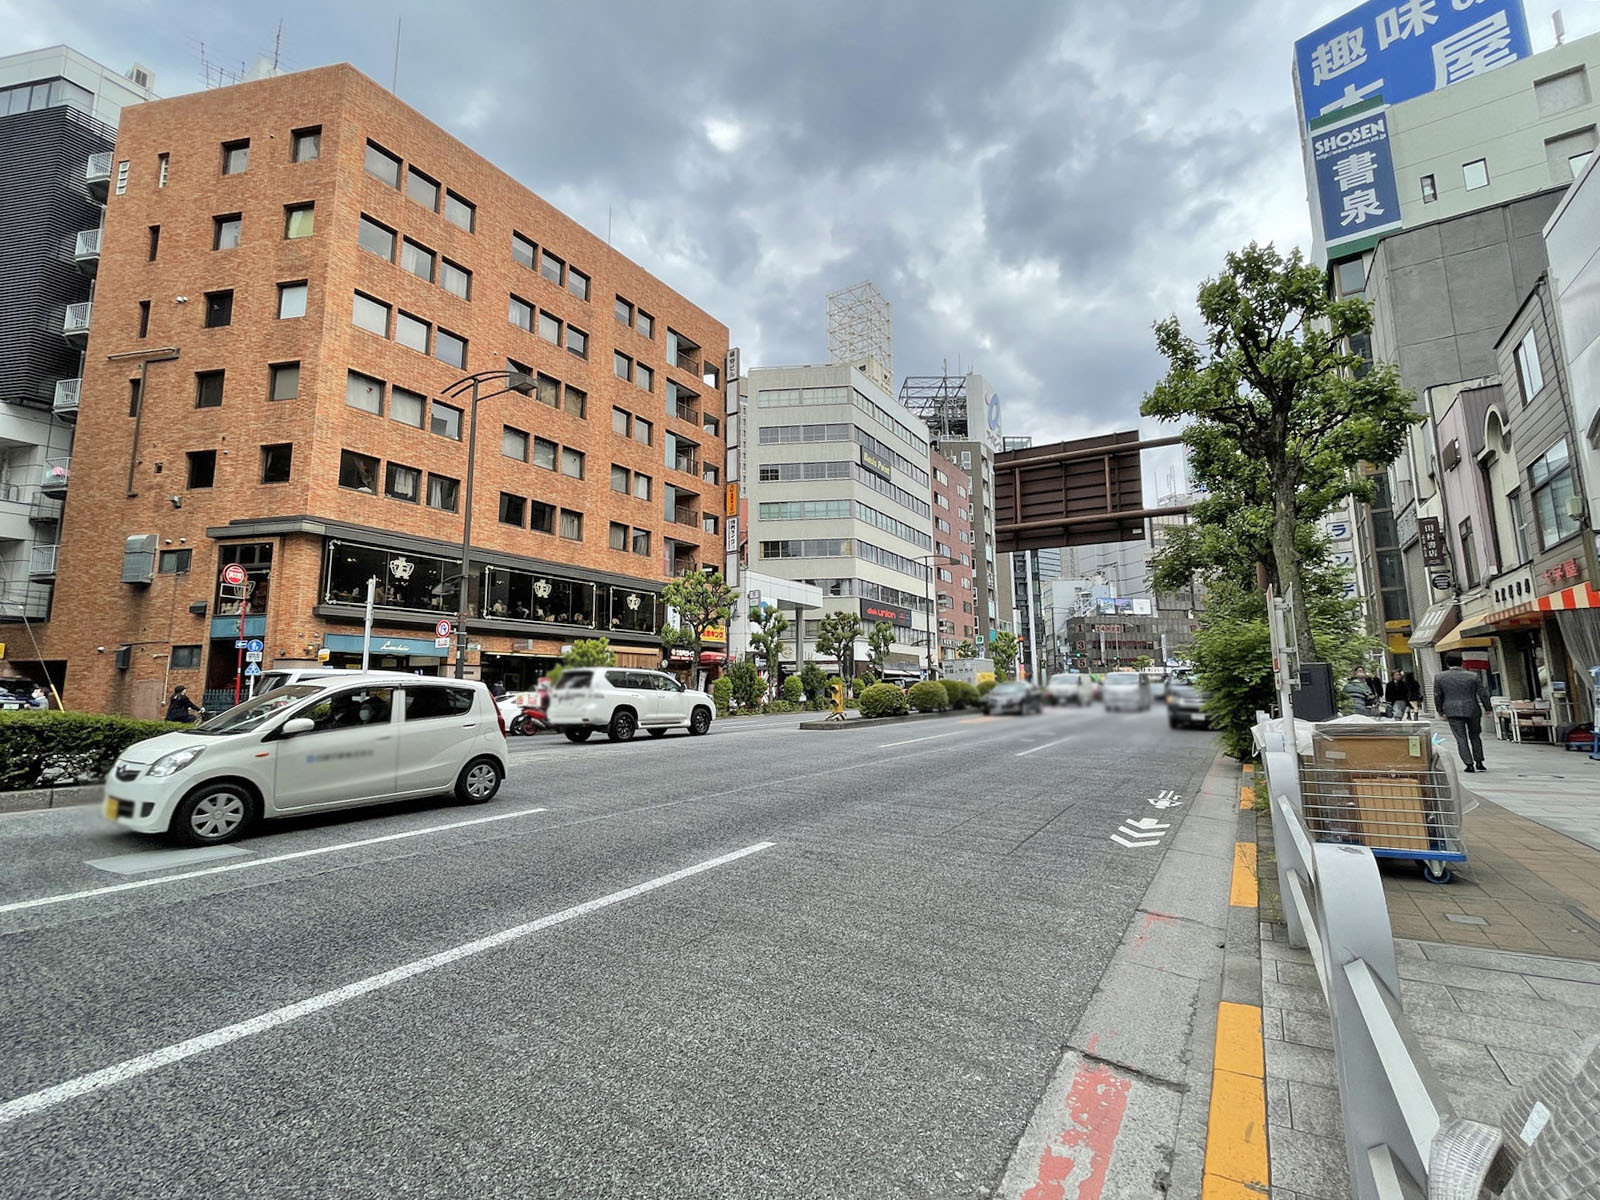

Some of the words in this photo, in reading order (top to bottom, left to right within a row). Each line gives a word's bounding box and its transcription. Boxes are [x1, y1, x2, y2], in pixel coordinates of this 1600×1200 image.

[1311, 0, 1488, 87] 趣味
[1314, 119, 1386, 155] SHOSEN
[1332, 151, 1385, 227] 書泉
[877, 609, 897, 620] union
